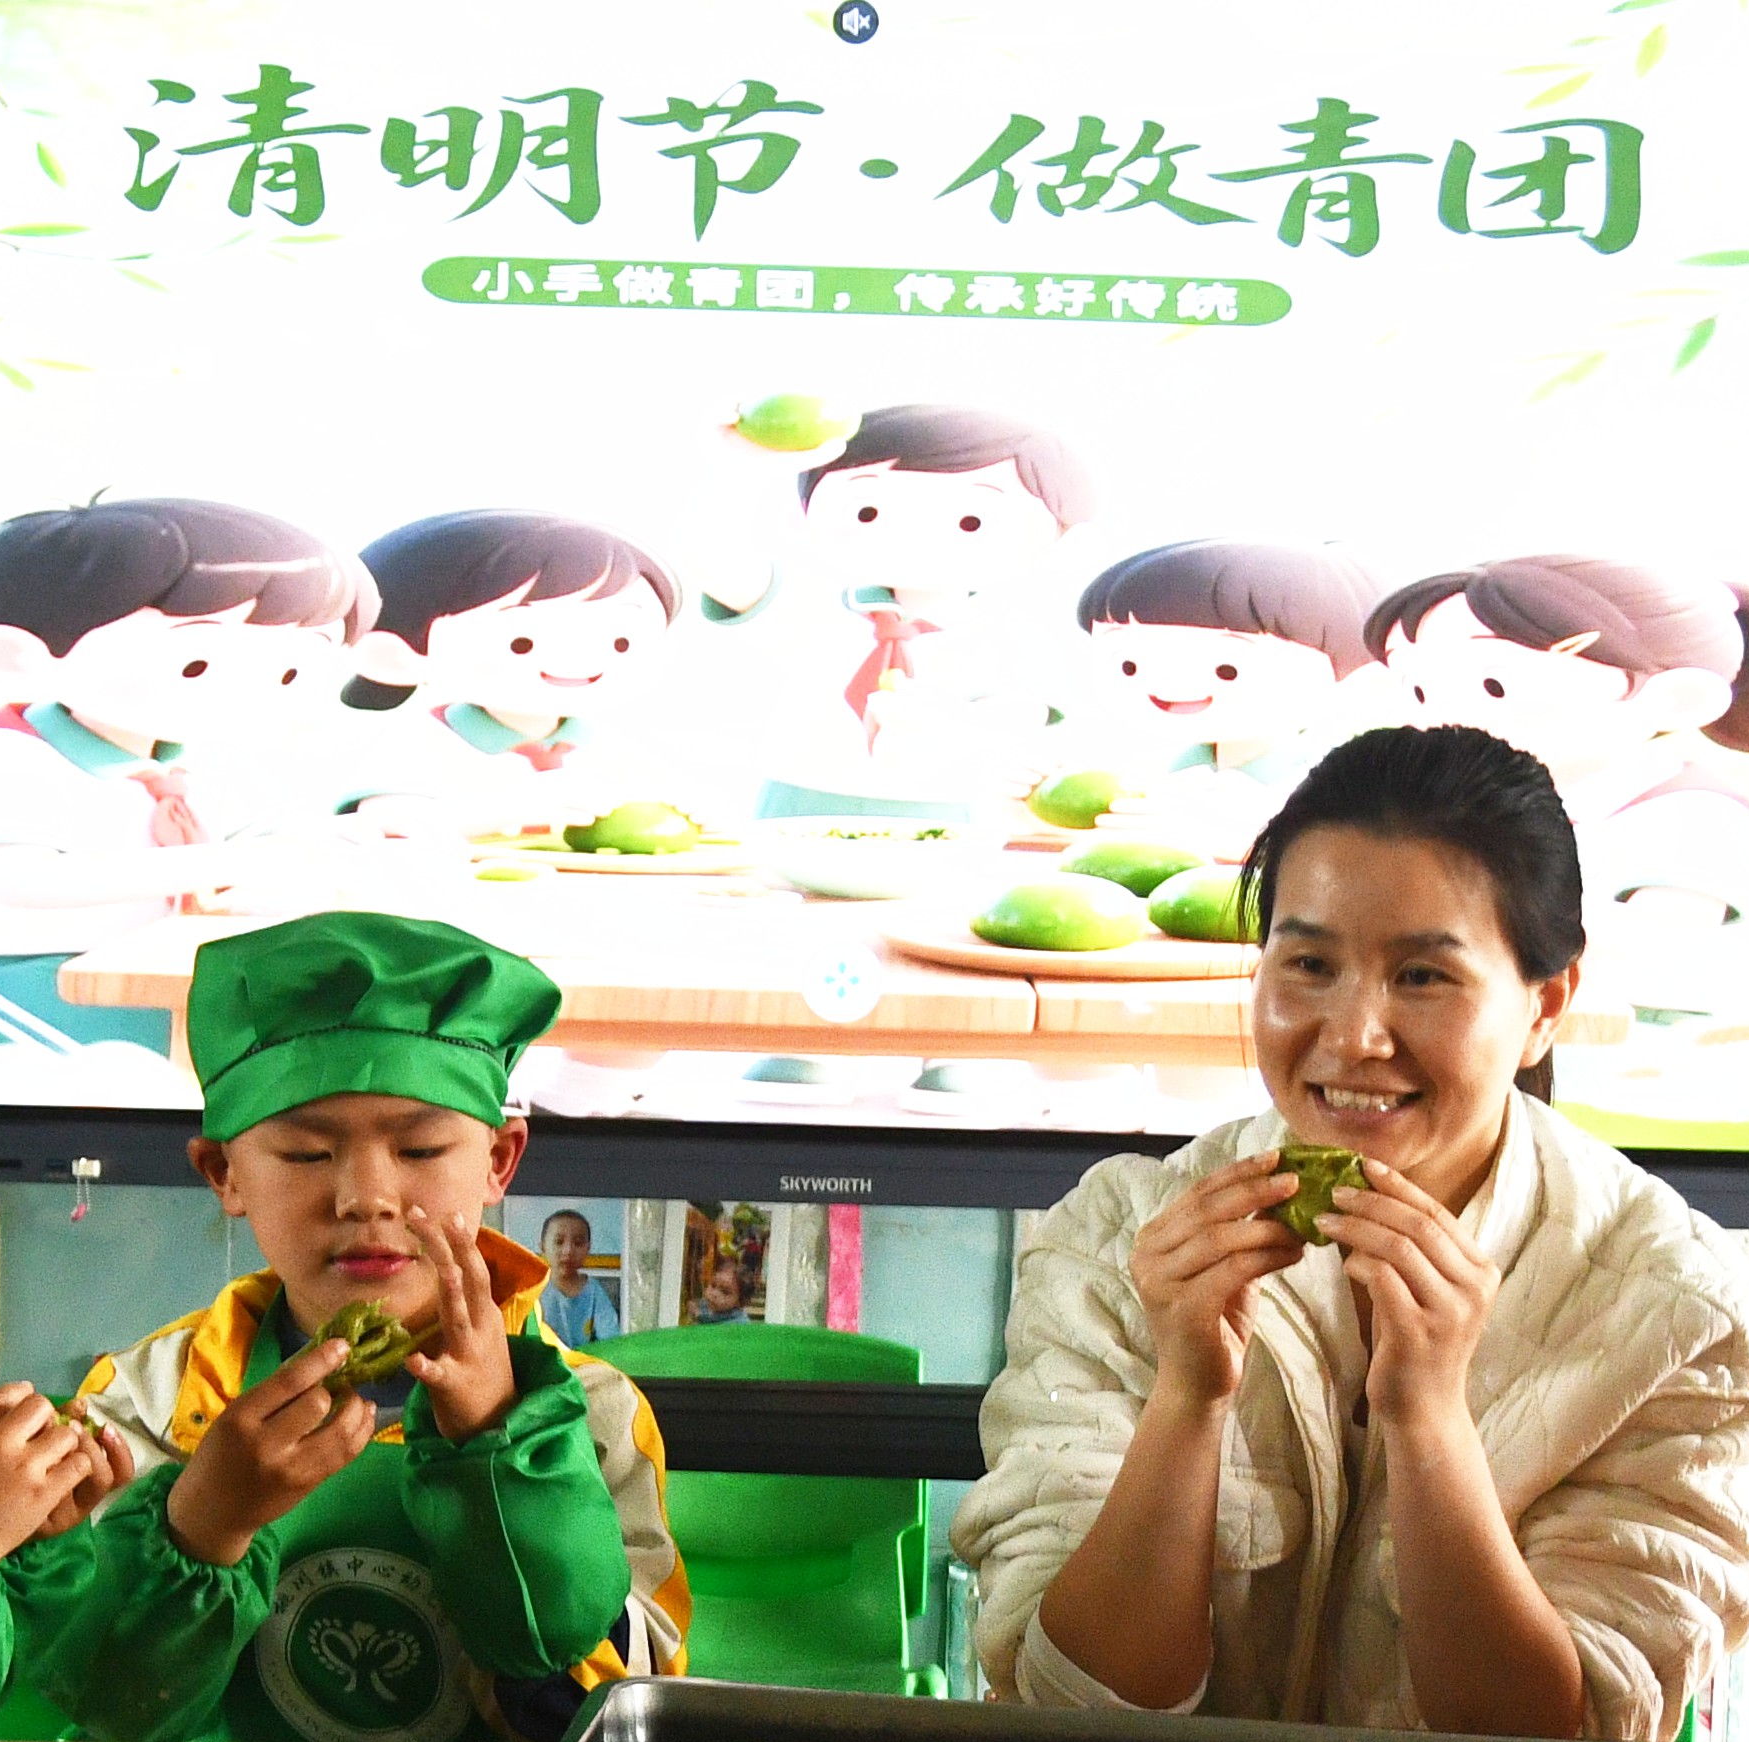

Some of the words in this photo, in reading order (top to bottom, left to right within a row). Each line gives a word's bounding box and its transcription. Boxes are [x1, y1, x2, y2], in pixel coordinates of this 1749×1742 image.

[122, 63, 1645, 257] 清明节·做青团
[471, 261, 1240, 322] 小手做青团，传承好传统
[779, 1175, 872, 1193] SKYWORTH
